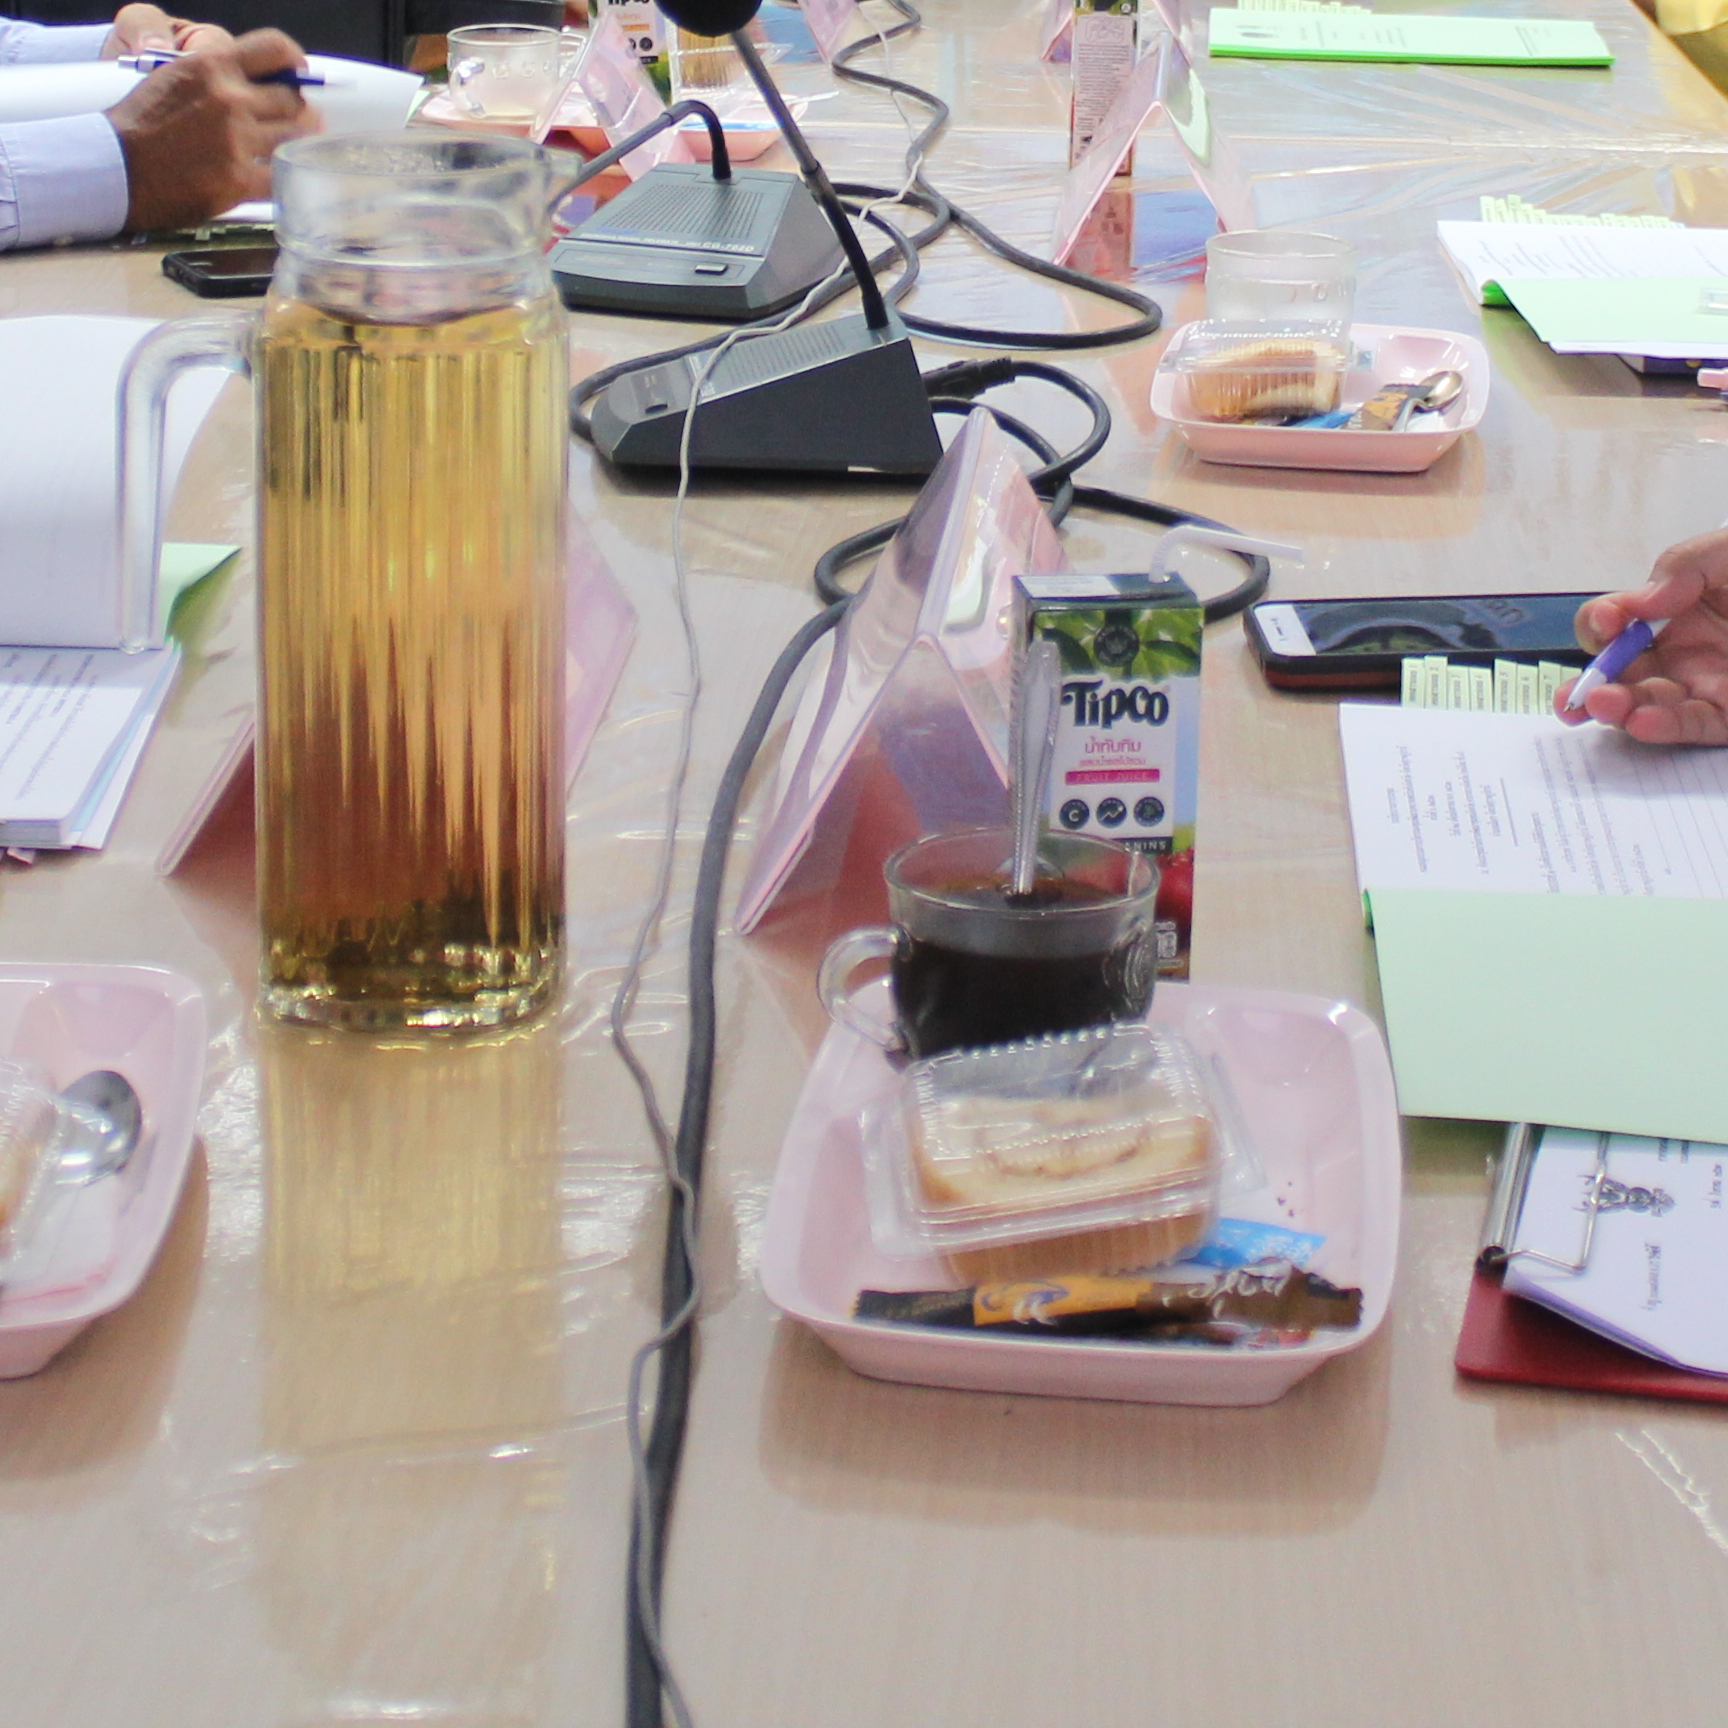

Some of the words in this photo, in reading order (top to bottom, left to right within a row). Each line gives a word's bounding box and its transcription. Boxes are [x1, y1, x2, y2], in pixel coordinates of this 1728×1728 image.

[1061, 680, 1170, 729] Tipco
[1084, 736, 1142, 754] น้ำทับทิม
